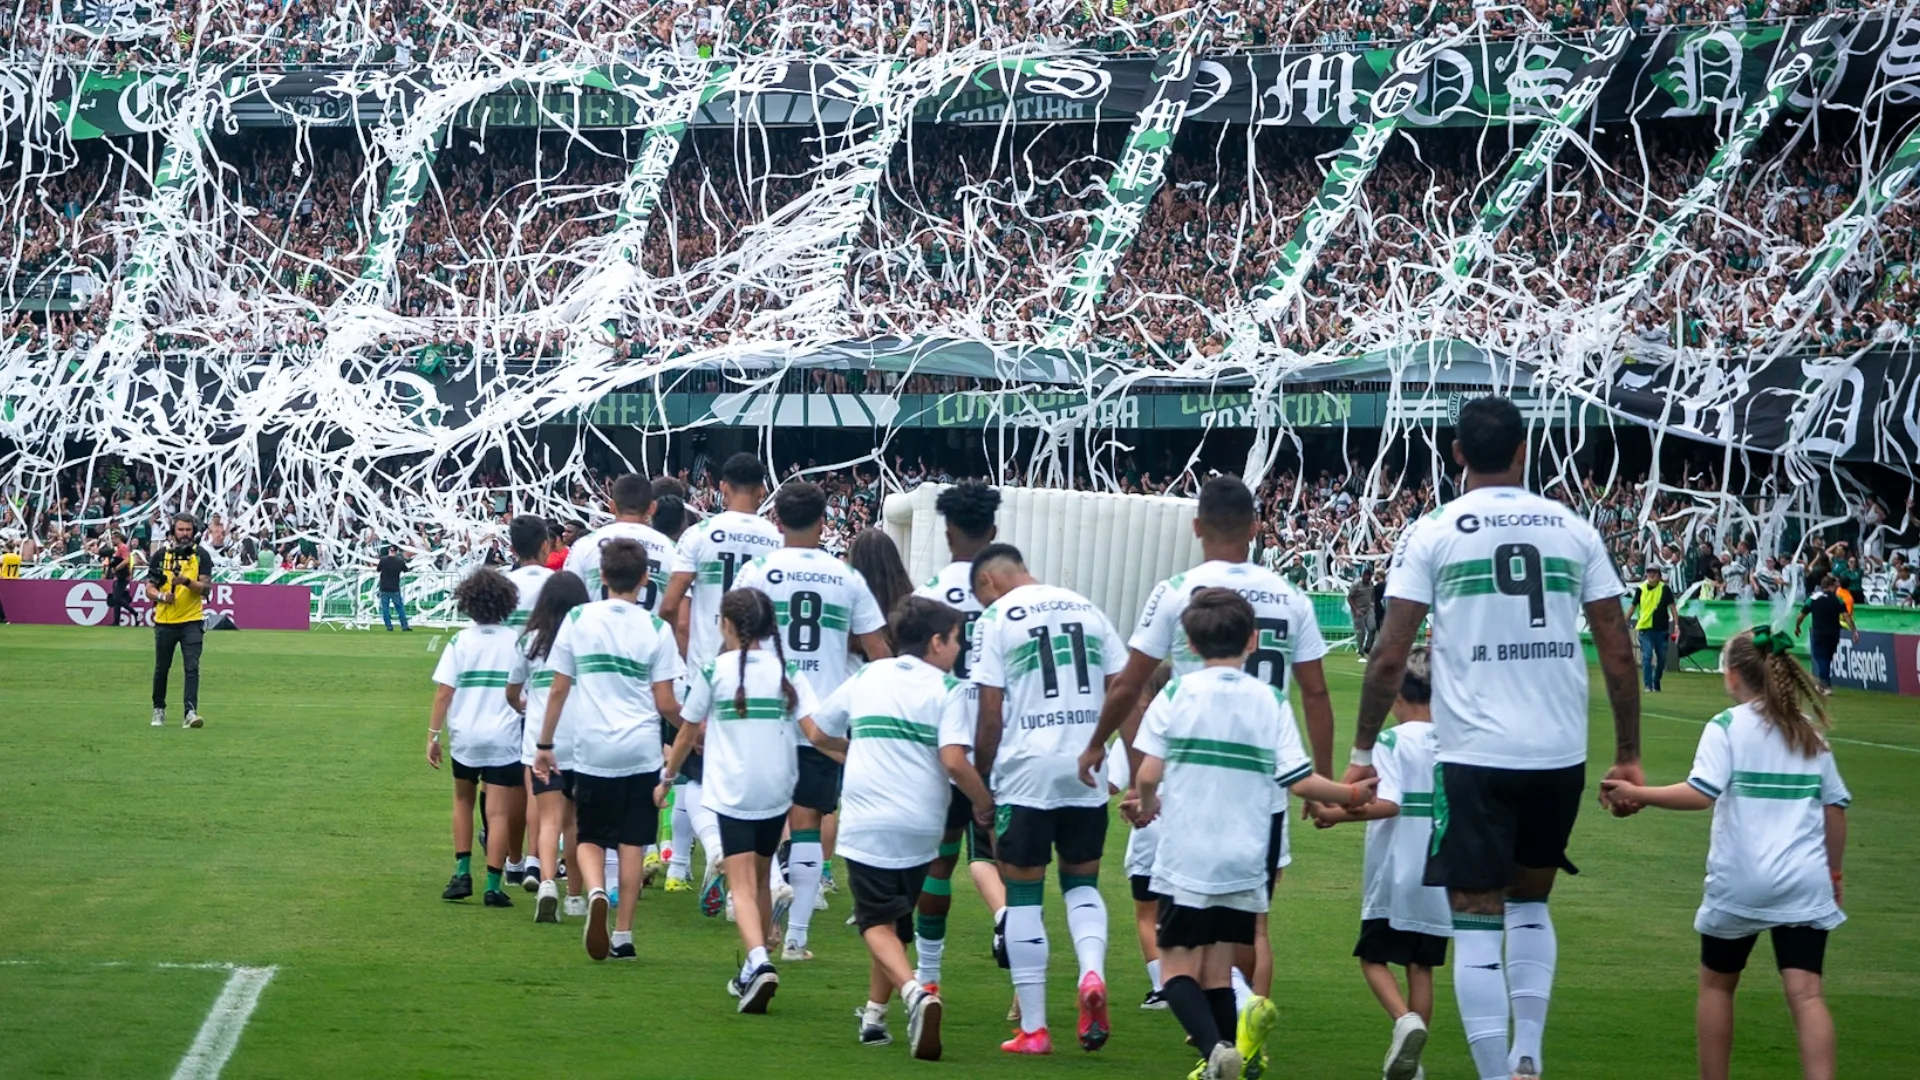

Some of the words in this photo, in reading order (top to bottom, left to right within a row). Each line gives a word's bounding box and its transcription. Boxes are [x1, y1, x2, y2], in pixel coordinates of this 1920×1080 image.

[1484, 513, 1566, 528] NEODENT
[639, 540, 665, 553] DENT
[729, 533, 781, 549] NEODENT
[787, 571, 844, 586] NEODENT
[1494, 543, 1546, 628] 9
[1236, 588, 1289, 605] ODENT
[1030, 601, 1092, 614] NEODENT
[788, 590, 822, 652] 8
[1028, 622, 1091, 699] 11
[1471, 644, 1492, 662] JR.
